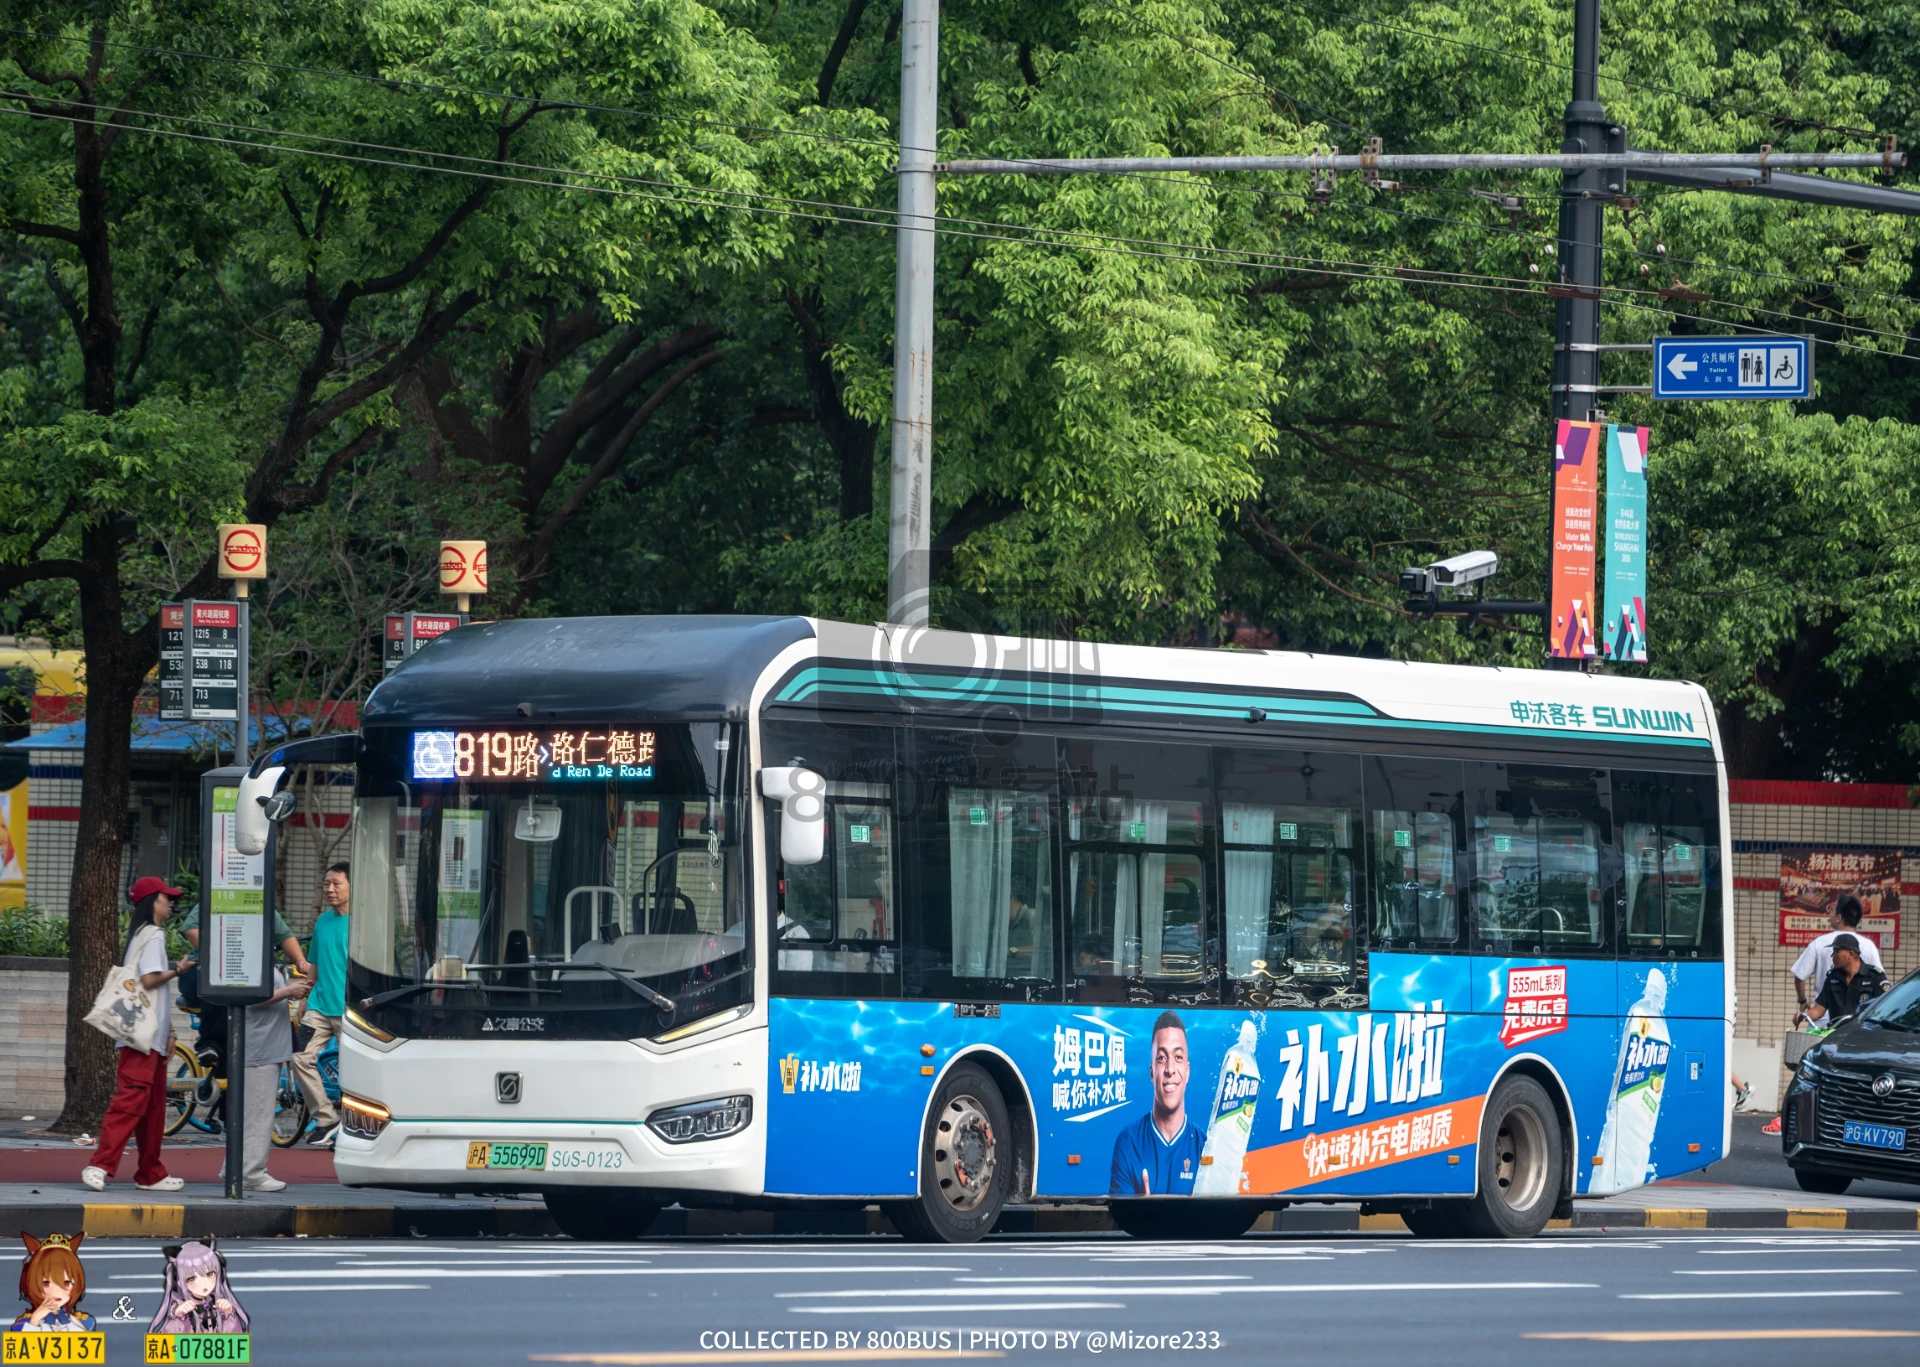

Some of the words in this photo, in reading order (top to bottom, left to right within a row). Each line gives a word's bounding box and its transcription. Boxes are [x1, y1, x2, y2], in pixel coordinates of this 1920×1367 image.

[1701, 352, 1736, 364] 公共厕所
[1614, 542, 1640, 554] SHANGHAI
[196, 609, 230, 620] 黄兴路国权路
[194, 629, 210, 639] 1215
[222, 629, 228, 640] 8
[416, 620, 451, 631] 黄兴路国权路
[195, 658, 209, 669] 538
[219, 659, 232, 670] 118
[195, 688, 209, 700] 713
[1510, 700, 1587, 727] 申沃客车
[1592, 706, 1695, 733] SUNWIN
[455, 732, 541, 778] 819路
[567, 764, 591, 777] Ren
[597, 764, 614, 777] De
[619, 764, 651, 777] Road
[224, 789, 231, 799] 8
[1809, 853, 1876, 873] 杨浦夜市
[217, 891, 235, 900] 118
[1512, 974, 1563, 994] 555mL系列
[1501, 998, 1567, 1035] 免费乐享
[1052, 1024, 1127, 1077] 姆巴佩
[1626, 1037, 1671, 1072] 补水啦
[1275, 999, 1447, 1132] 补水啦
[800, 1061, 862, 1092] 补水啦
[1052, 1077, 1127, 1112] 喊你补水啦
[1223, 1073, 1260, 1102] 补水啦
[1308, 1108, 1453, 1178] 快速补充电解质
